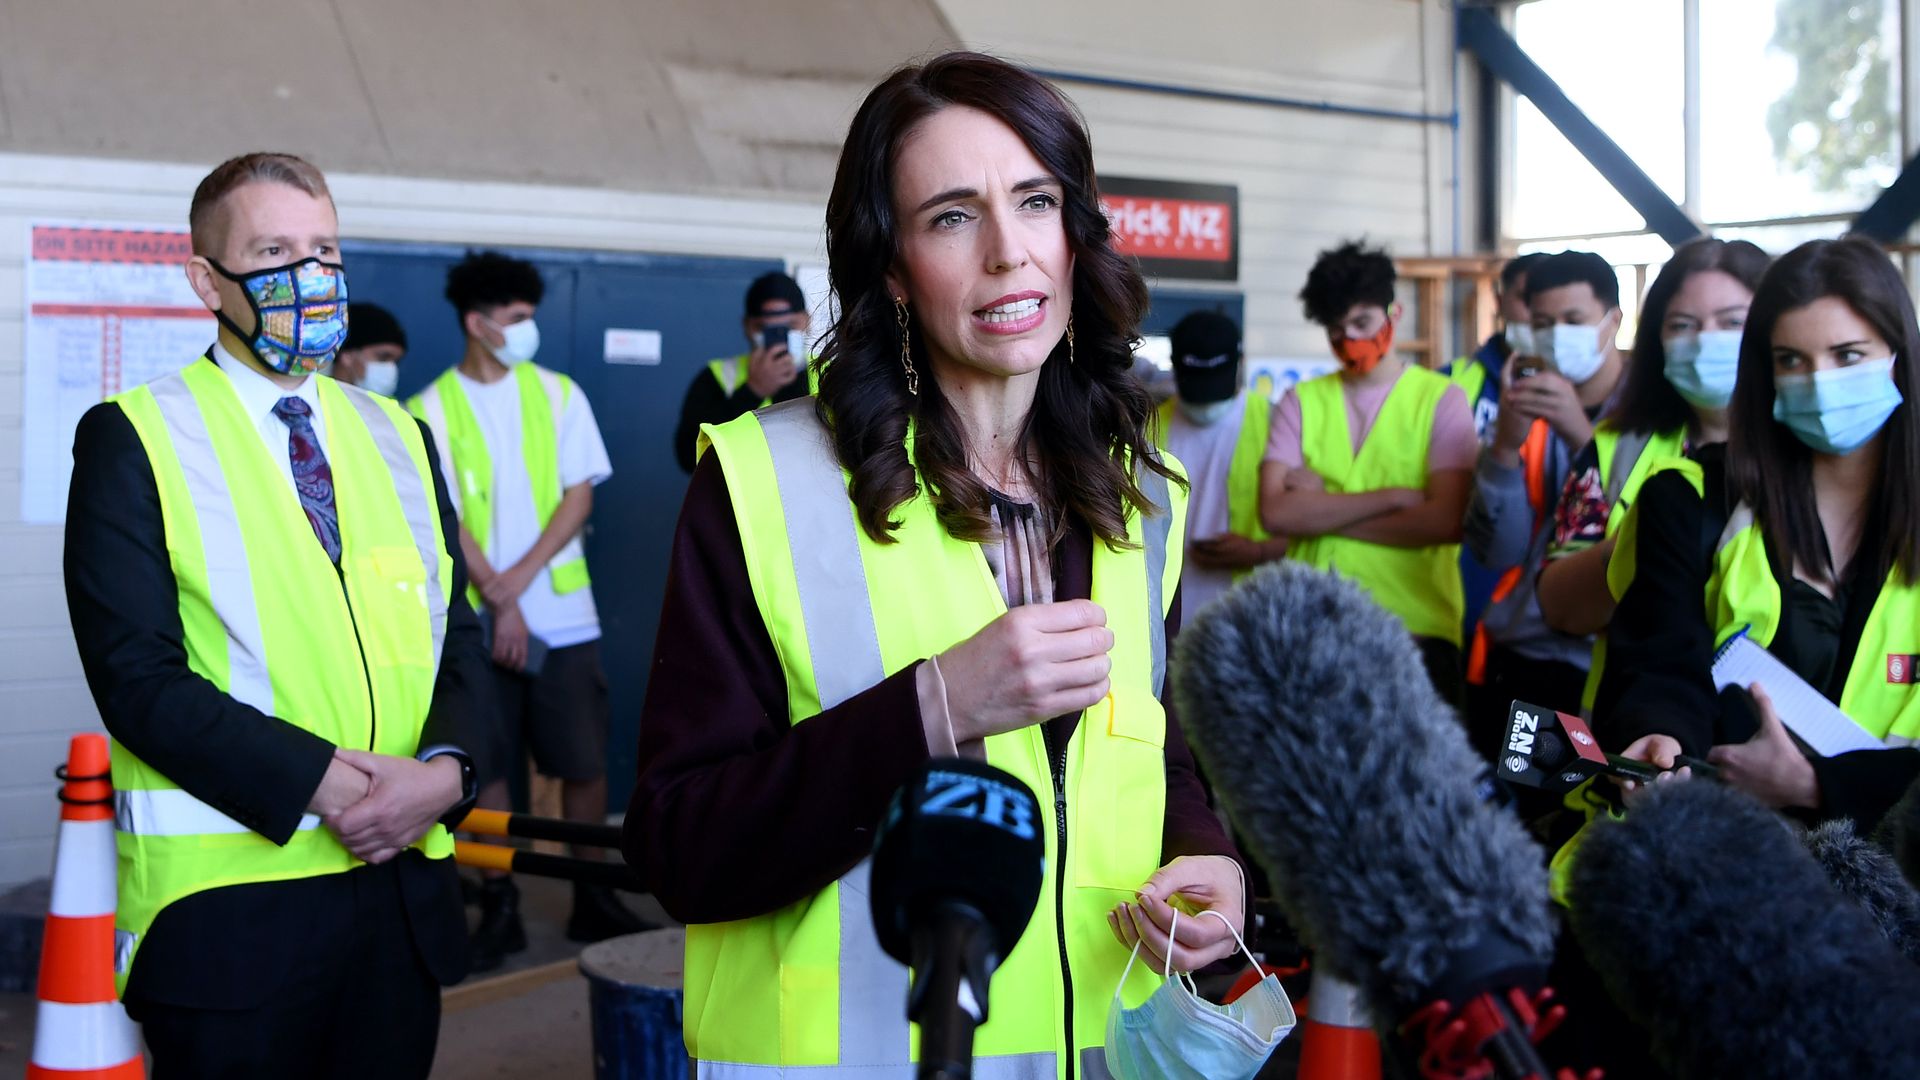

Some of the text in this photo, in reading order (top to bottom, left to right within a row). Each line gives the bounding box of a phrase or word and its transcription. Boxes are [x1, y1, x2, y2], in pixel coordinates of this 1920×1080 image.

[1101, 200, 1222, 241] rick NZ
[36, 236, 189, 255] ON SITE HAZAR
[1508, 710, 1524, 751] RADIO
[1515, 711, 1539, 755] NZ
[920, 776, 1036, 841] ZB
